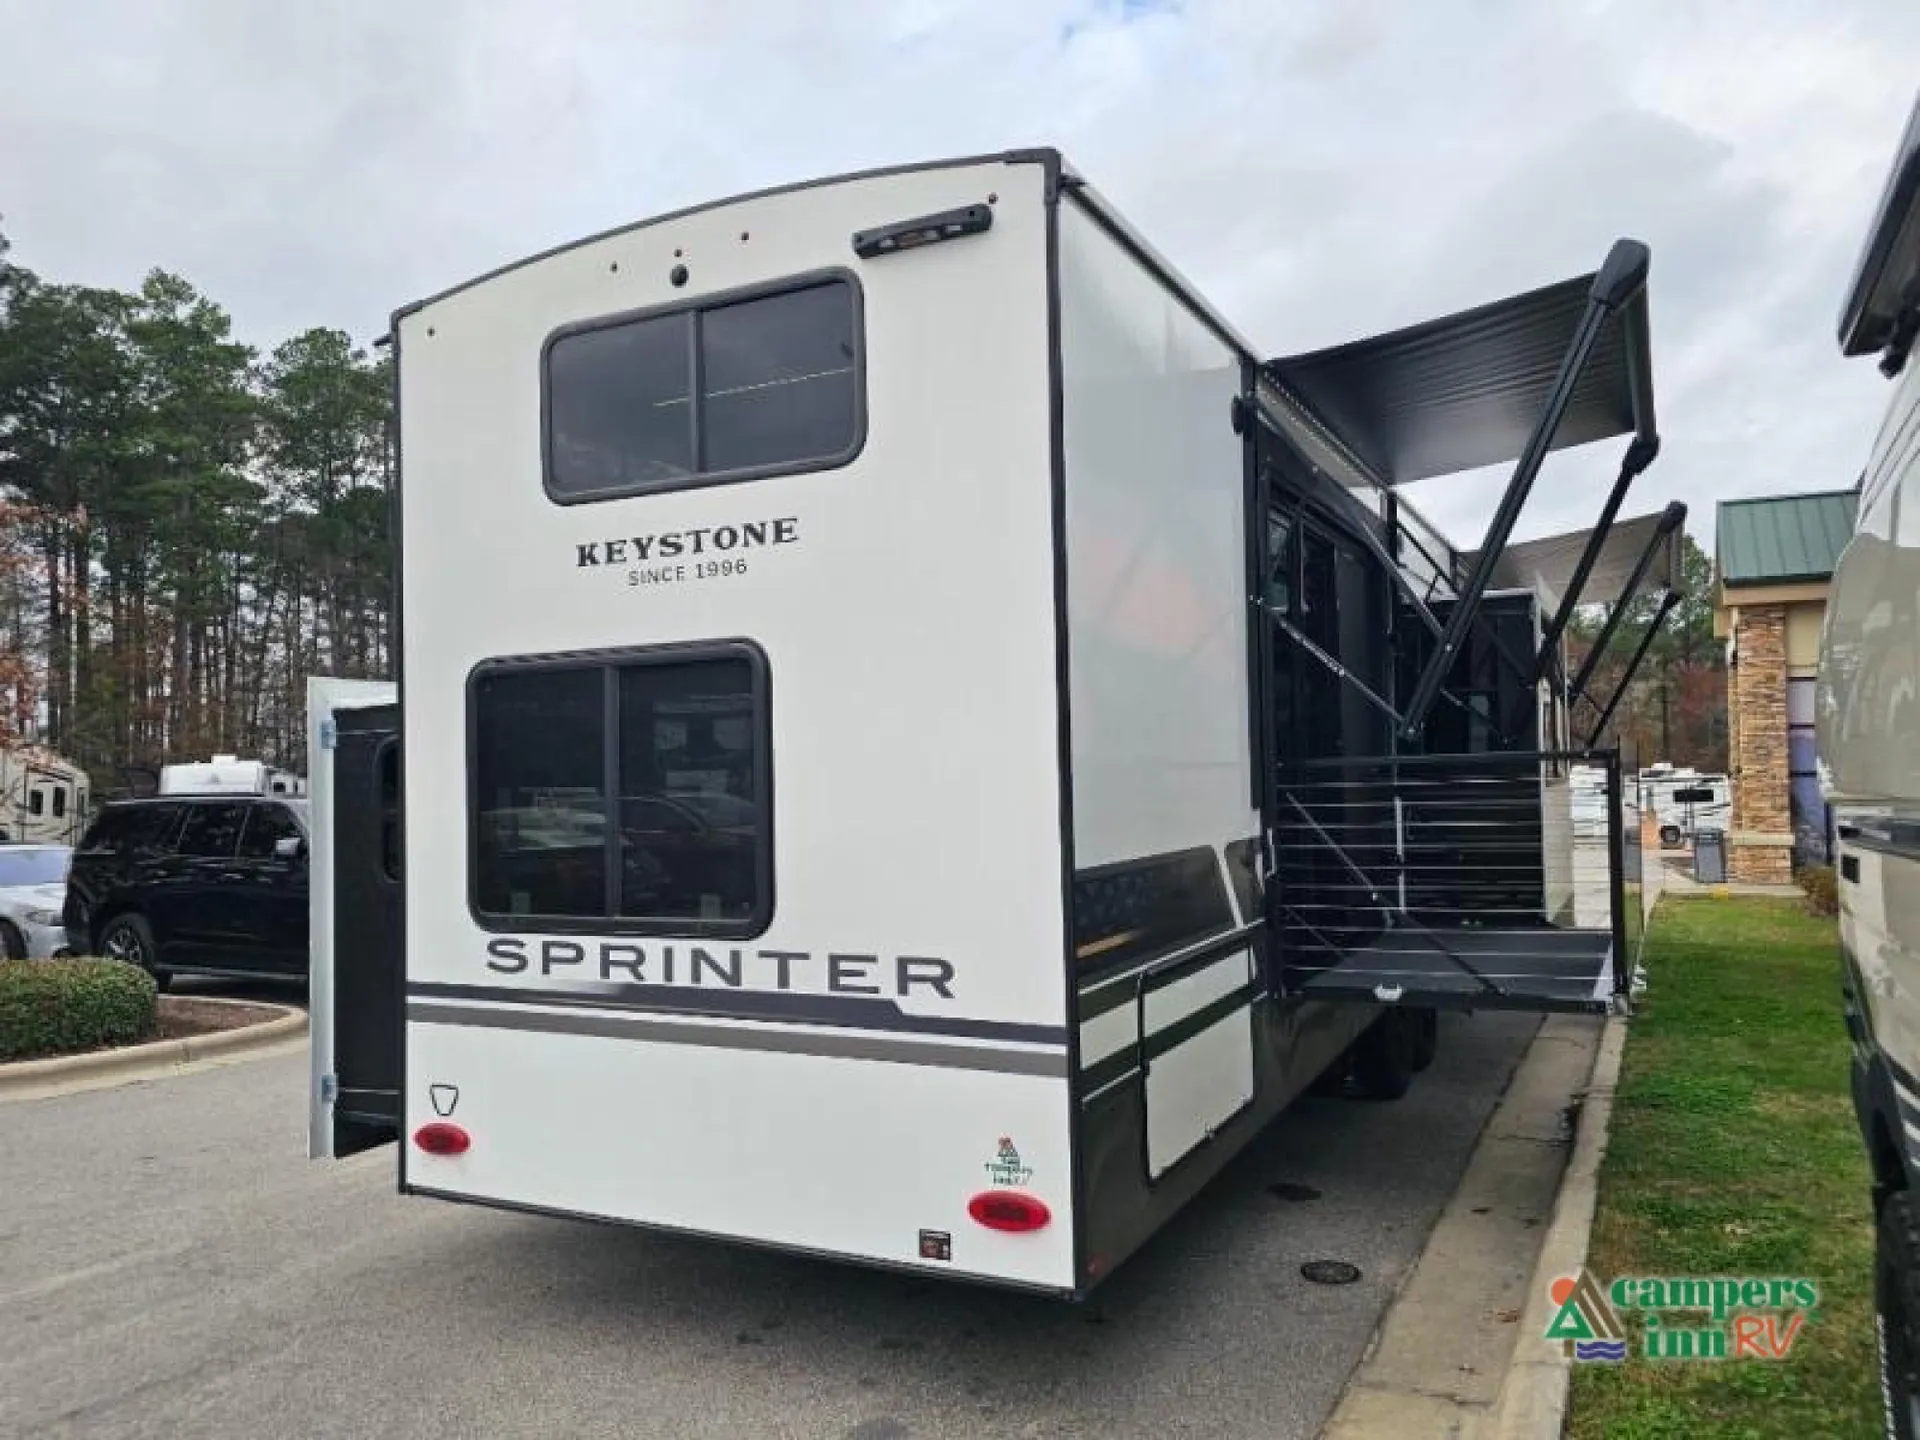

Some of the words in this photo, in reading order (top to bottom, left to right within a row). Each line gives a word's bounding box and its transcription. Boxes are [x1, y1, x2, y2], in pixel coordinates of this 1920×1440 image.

[575, 516, 800, 567] KEYSTONE
[628, 565, 685, 586] SINCE
[695, 558, 748, 579] 1996
[486, 938, 956, 999] SPRINTER
